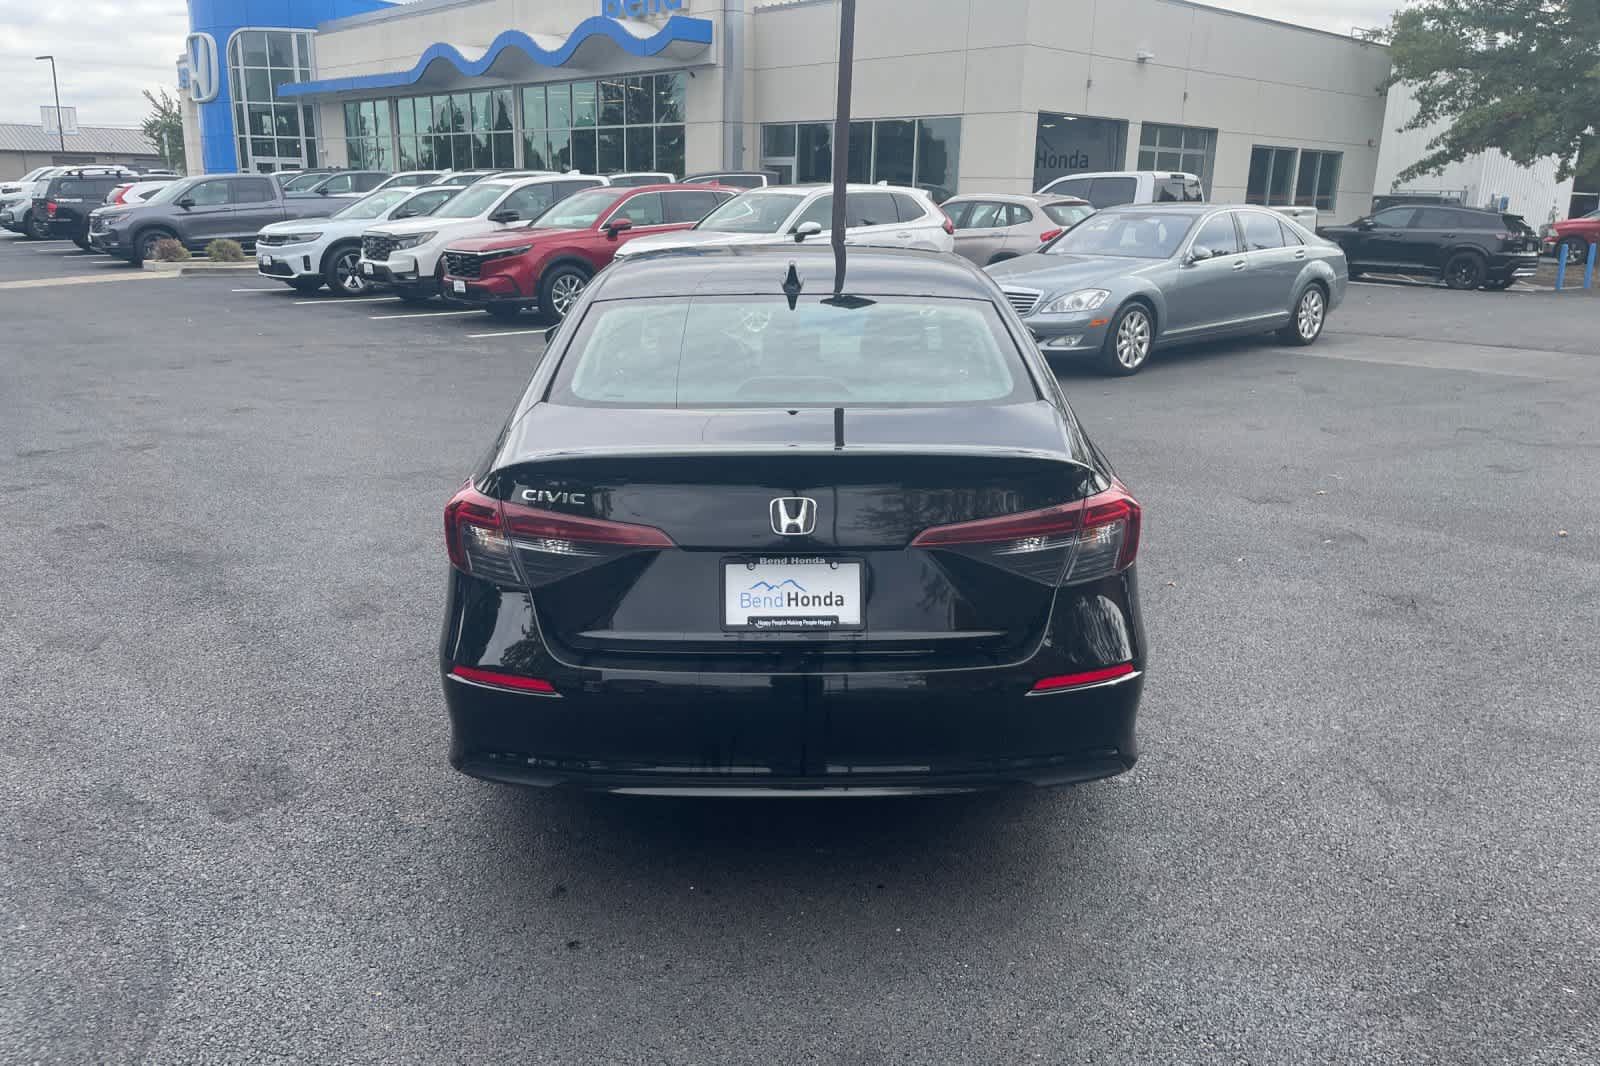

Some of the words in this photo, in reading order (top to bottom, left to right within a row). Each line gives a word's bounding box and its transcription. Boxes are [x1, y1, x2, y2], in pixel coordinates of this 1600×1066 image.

[1036, 148, 1089, 169] Honda
[521, 489, 586, 504] CIVIC
[760, 557, 788, 565] Bend
[790, 557, 825, 565] Honda
[740, 592, 784, 608] Bend
[787, 591, 844, 607] Honda
